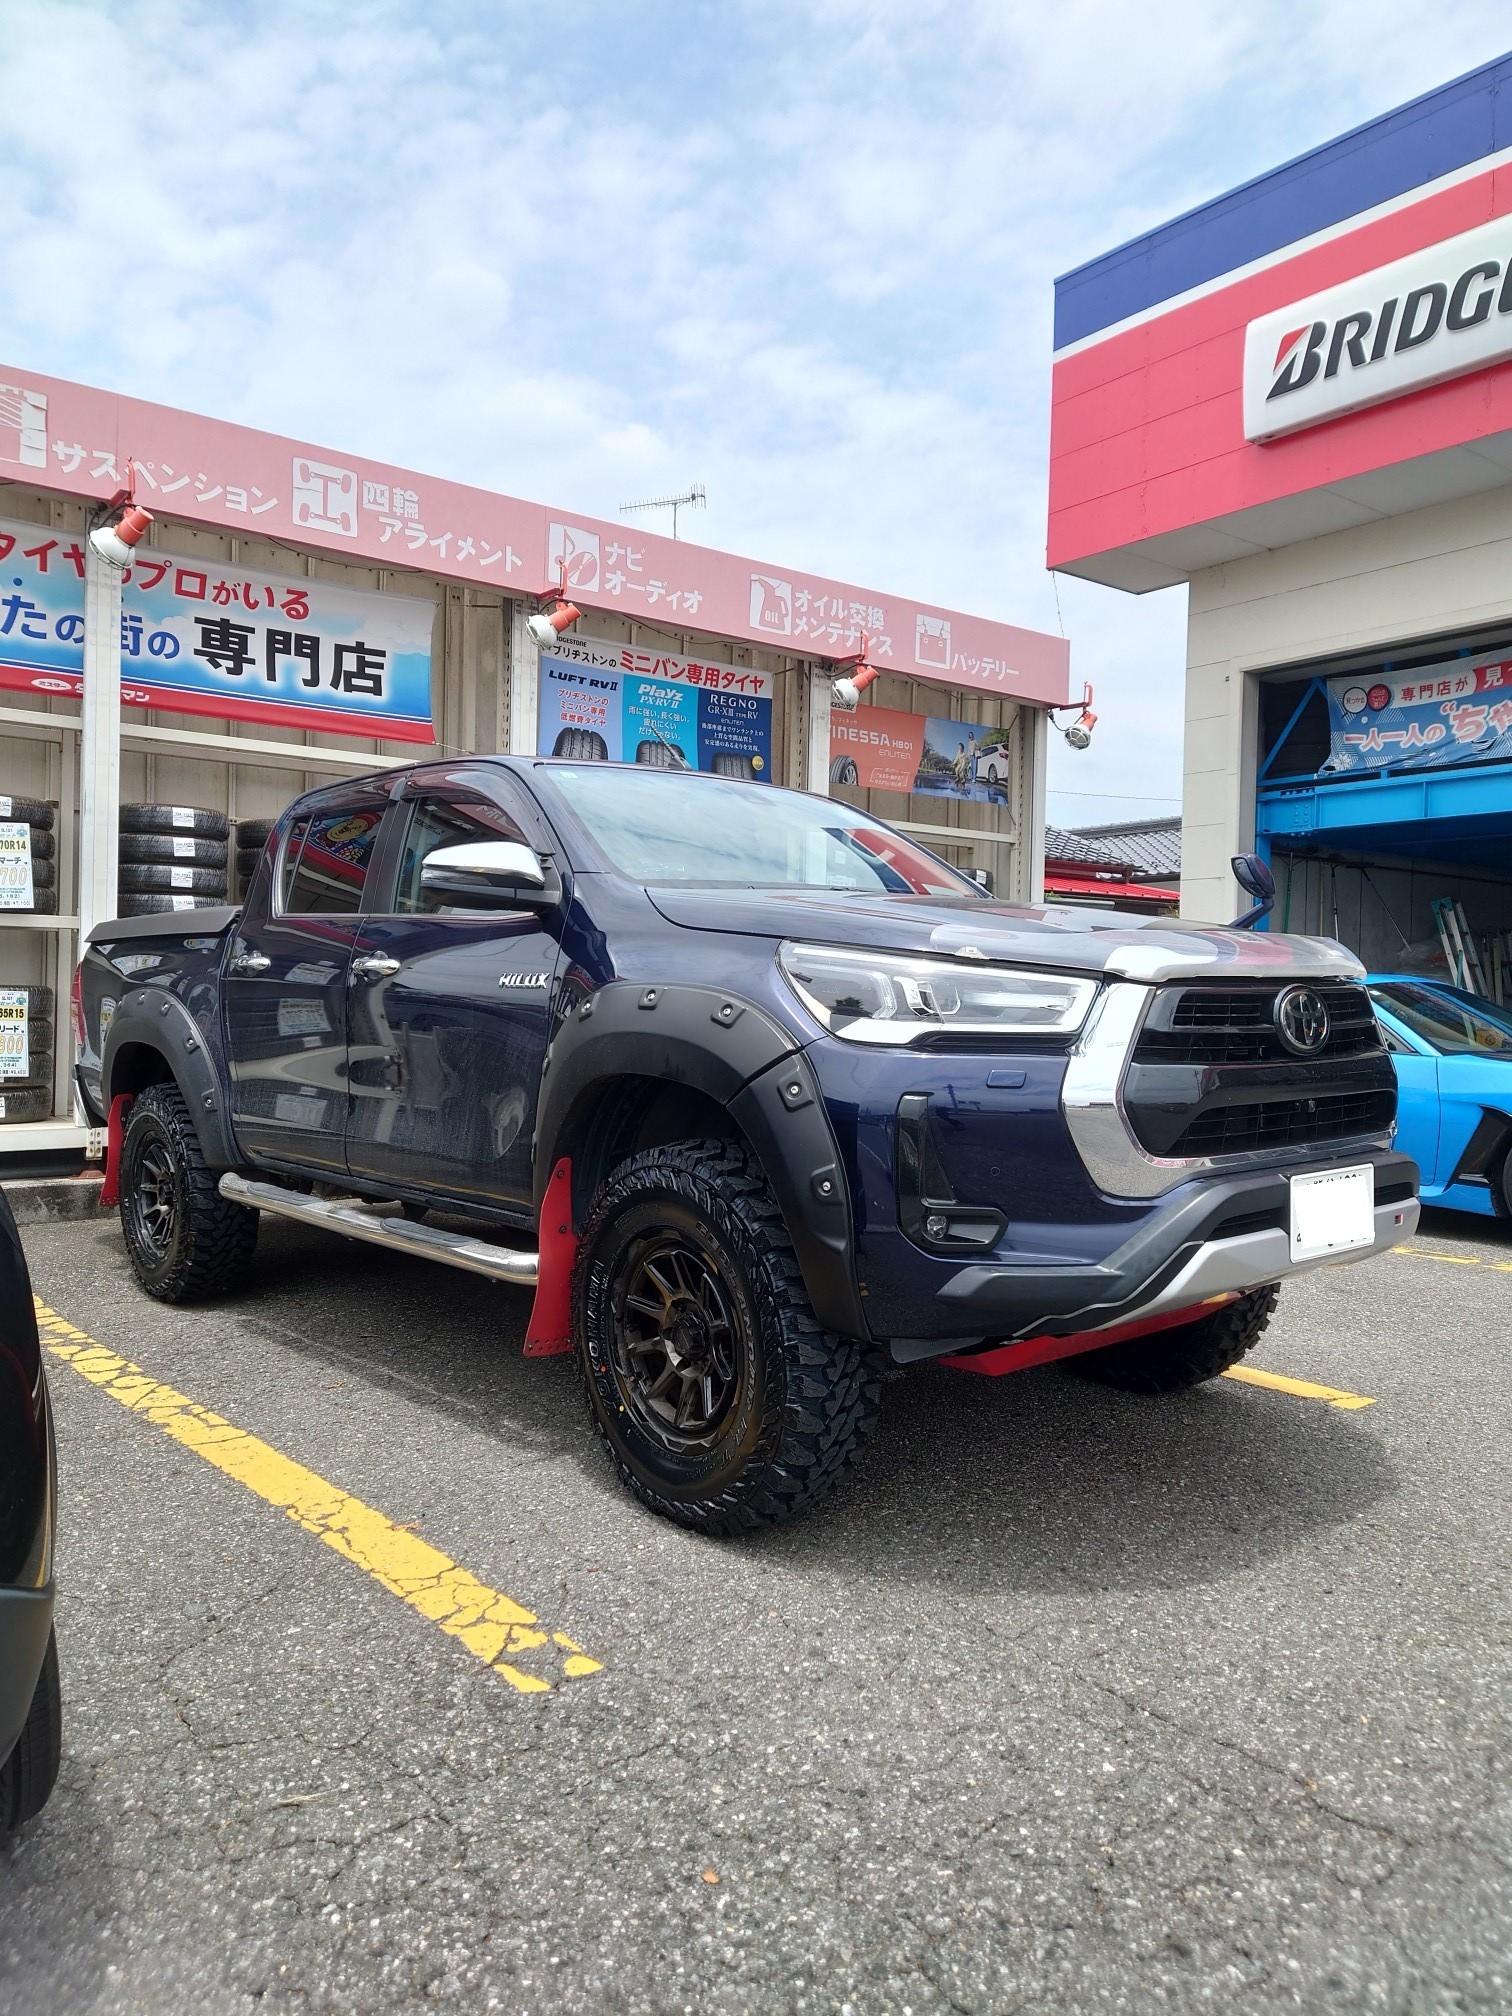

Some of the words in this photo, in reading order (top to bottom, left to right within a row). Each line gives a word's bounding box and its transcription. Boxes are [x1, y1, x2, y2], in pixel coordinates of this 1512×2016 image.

[52, 440, 278, 515] サスペンション
[362, 480, 420, 520] 四輪
[378, 516, 523, 573] アライメント
[604, 542, 645, 572] ナビ
[604, 570, 703, 614] オーディオ
[764, 610, 780, 624] OIL
[794, 590, 885, 631] オイル交換
[548, 669, 588, 685] LUFT
[951, 653, 1020, 681] バッテリー
[558, 689, 609, 706] ブリヂストンの
[638, 683, 684, 701] Playz
[710, 694, 757, 710] REGNO
[560, 700, 606, 717] ミニバン専用
[560, 712, 606, 728] 低燃費タイヤ
[830, 725, 890, 747] INESSA
[892, 740, 913, 750] HB01
[499, 972, 551, 989] HILUX
